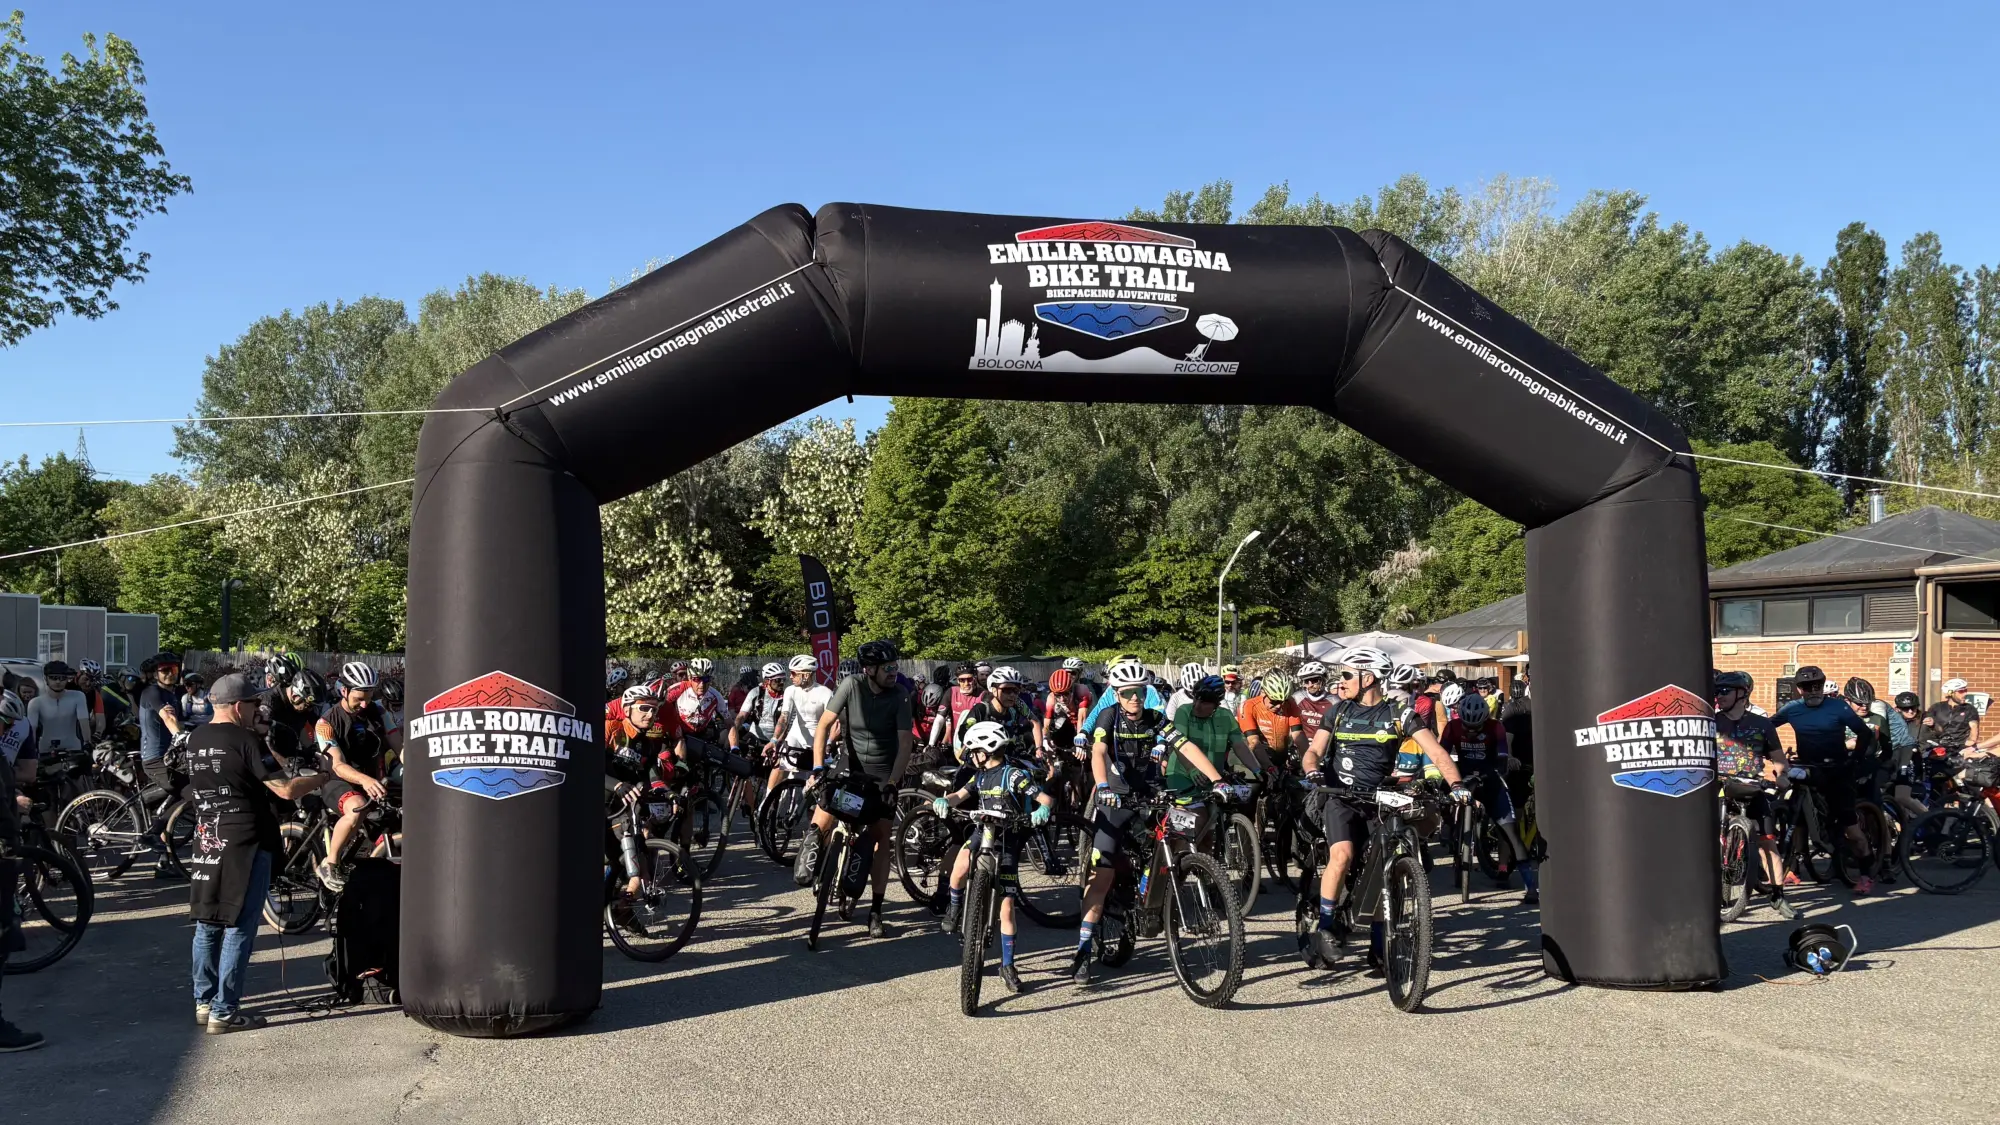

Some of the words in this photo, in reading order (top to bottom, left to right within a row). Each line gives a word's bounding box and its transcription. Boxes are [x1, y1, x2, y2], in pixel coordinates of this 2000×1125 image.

[987, 242, 1231, 272] EMILIA-ROMAGNA
[1027, 264, 1101, 287] BIKE
[1104, 265, 1194, 293] TRAIL
[1046, 289, 1115, 299] BIKEPACKING
[1117, 289, 1177, 302] ADVENTURE
[549, 281, 795, 406] www.emiliaromagnabiketrail.it
[977, 358, 1043, 370] BOLOGNA
[1173, 362, 1238, 373] RICCIONE
[1416, 309, 1628, 444] www.emiliaromagnabiketrail.it
[809, 581, 834, 685] BIOTEX
[410, 711, 593, 743] EMILIA-ROMAGNA
[428, 734, 486, 758] BIKE
[491, 734, 570, 760] TRAIL
[1604, 740, 1665, 762] BIKE
[1669, 739, 1715, 758] TRAIL
[440, 755, 500, 766] BIKEPACKING
[501, 756, 557, 767] ADVENTURE
[1621, 759, 1676, 769] BIKEPACKING
